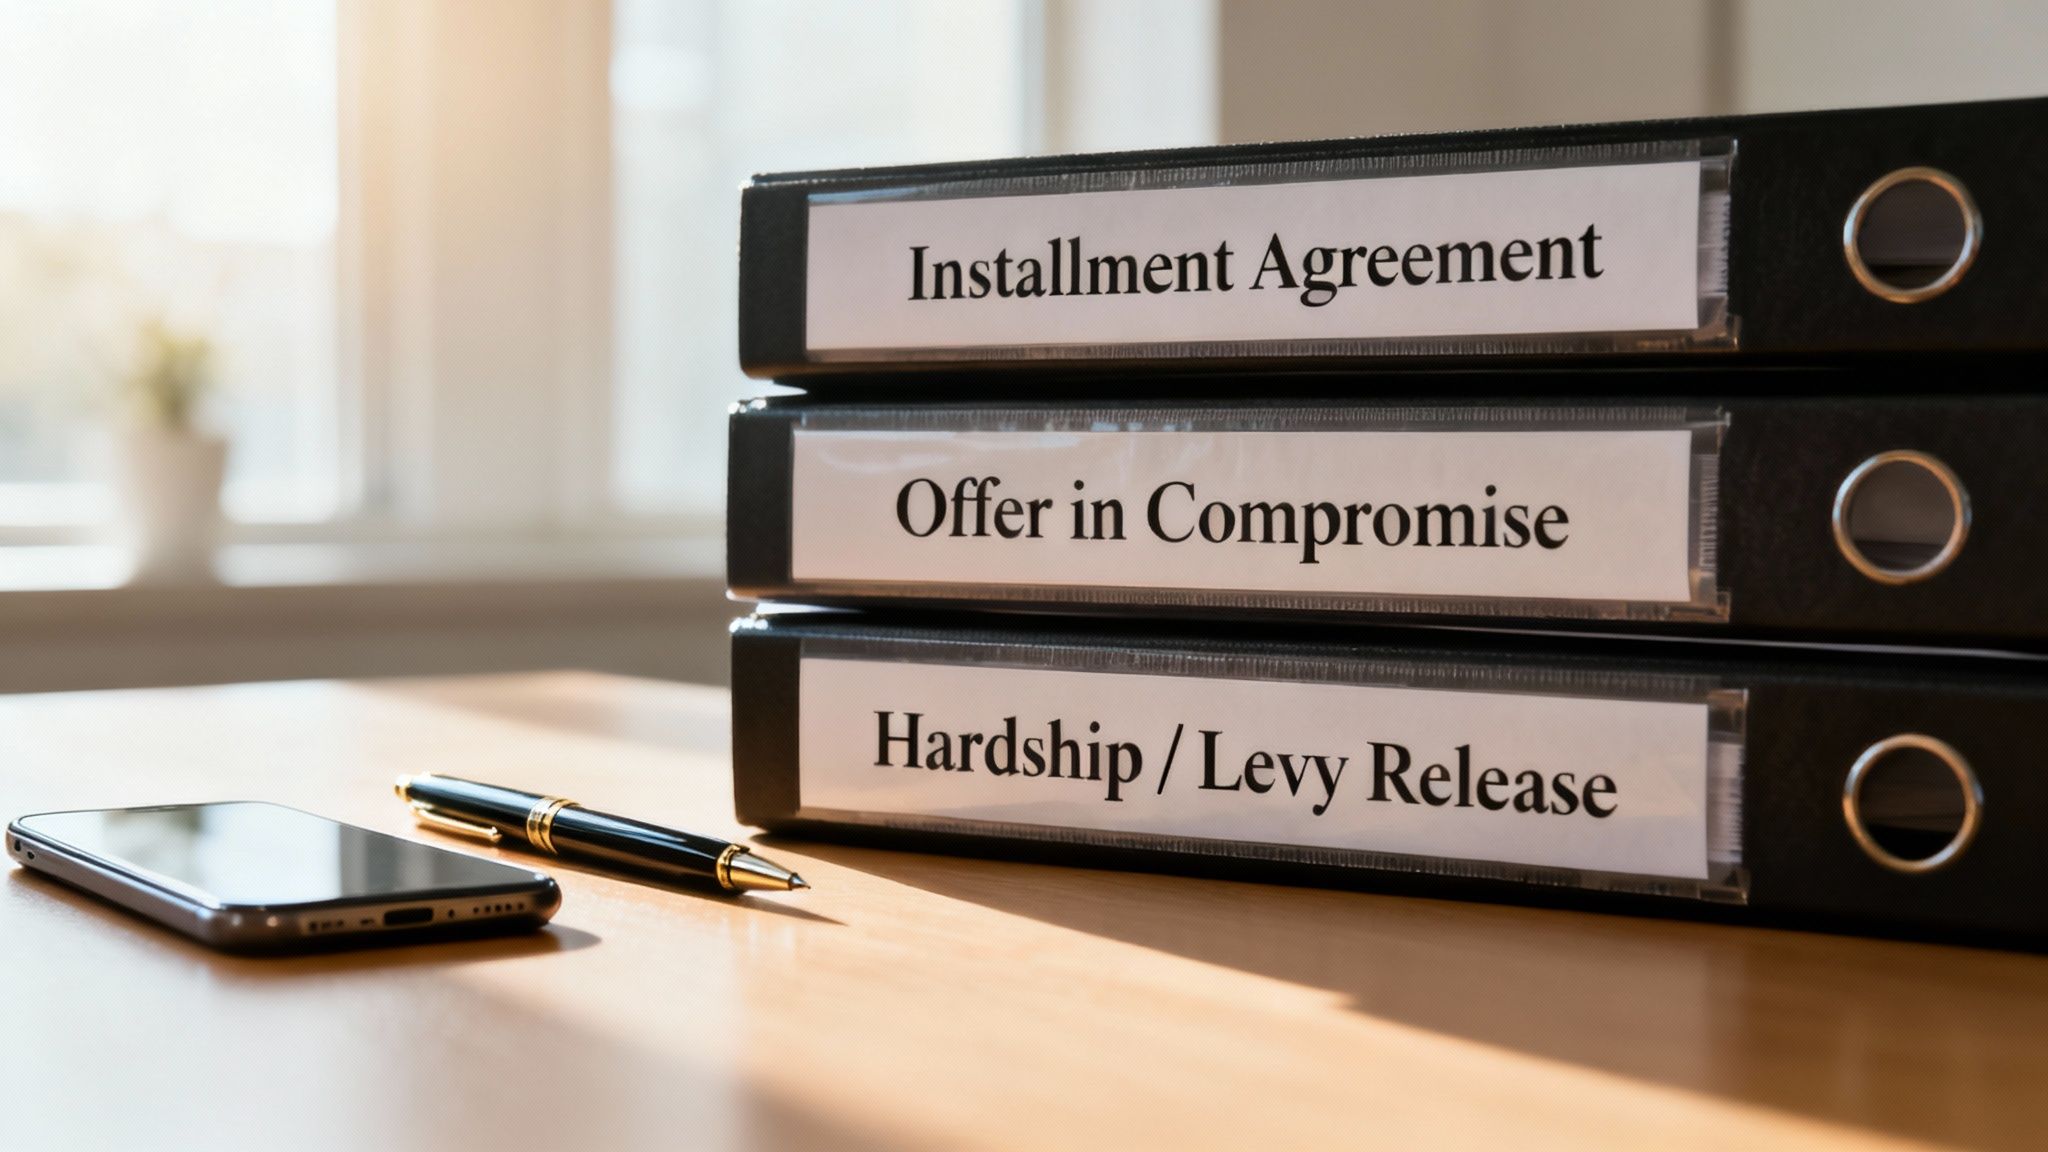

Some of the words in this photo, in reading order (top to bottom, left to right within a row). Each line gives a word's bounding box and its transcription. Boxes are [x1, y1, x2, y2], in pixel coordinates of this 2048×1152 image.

[907, 236, 1235, 301] Installment
[1248, 223, 1604, 308] Agreement
[896, 475, 1054, 539] Offer
[1070, 479, 1127, 540] in
[1147, 481, 1570, 565] Compromise
[874, 711, 1143, 802] Hardship
[1156, 723, 1184, 796] /
[1197, 729, 1350, 817] Levy
[1366, 741, 1618, 819] Release
